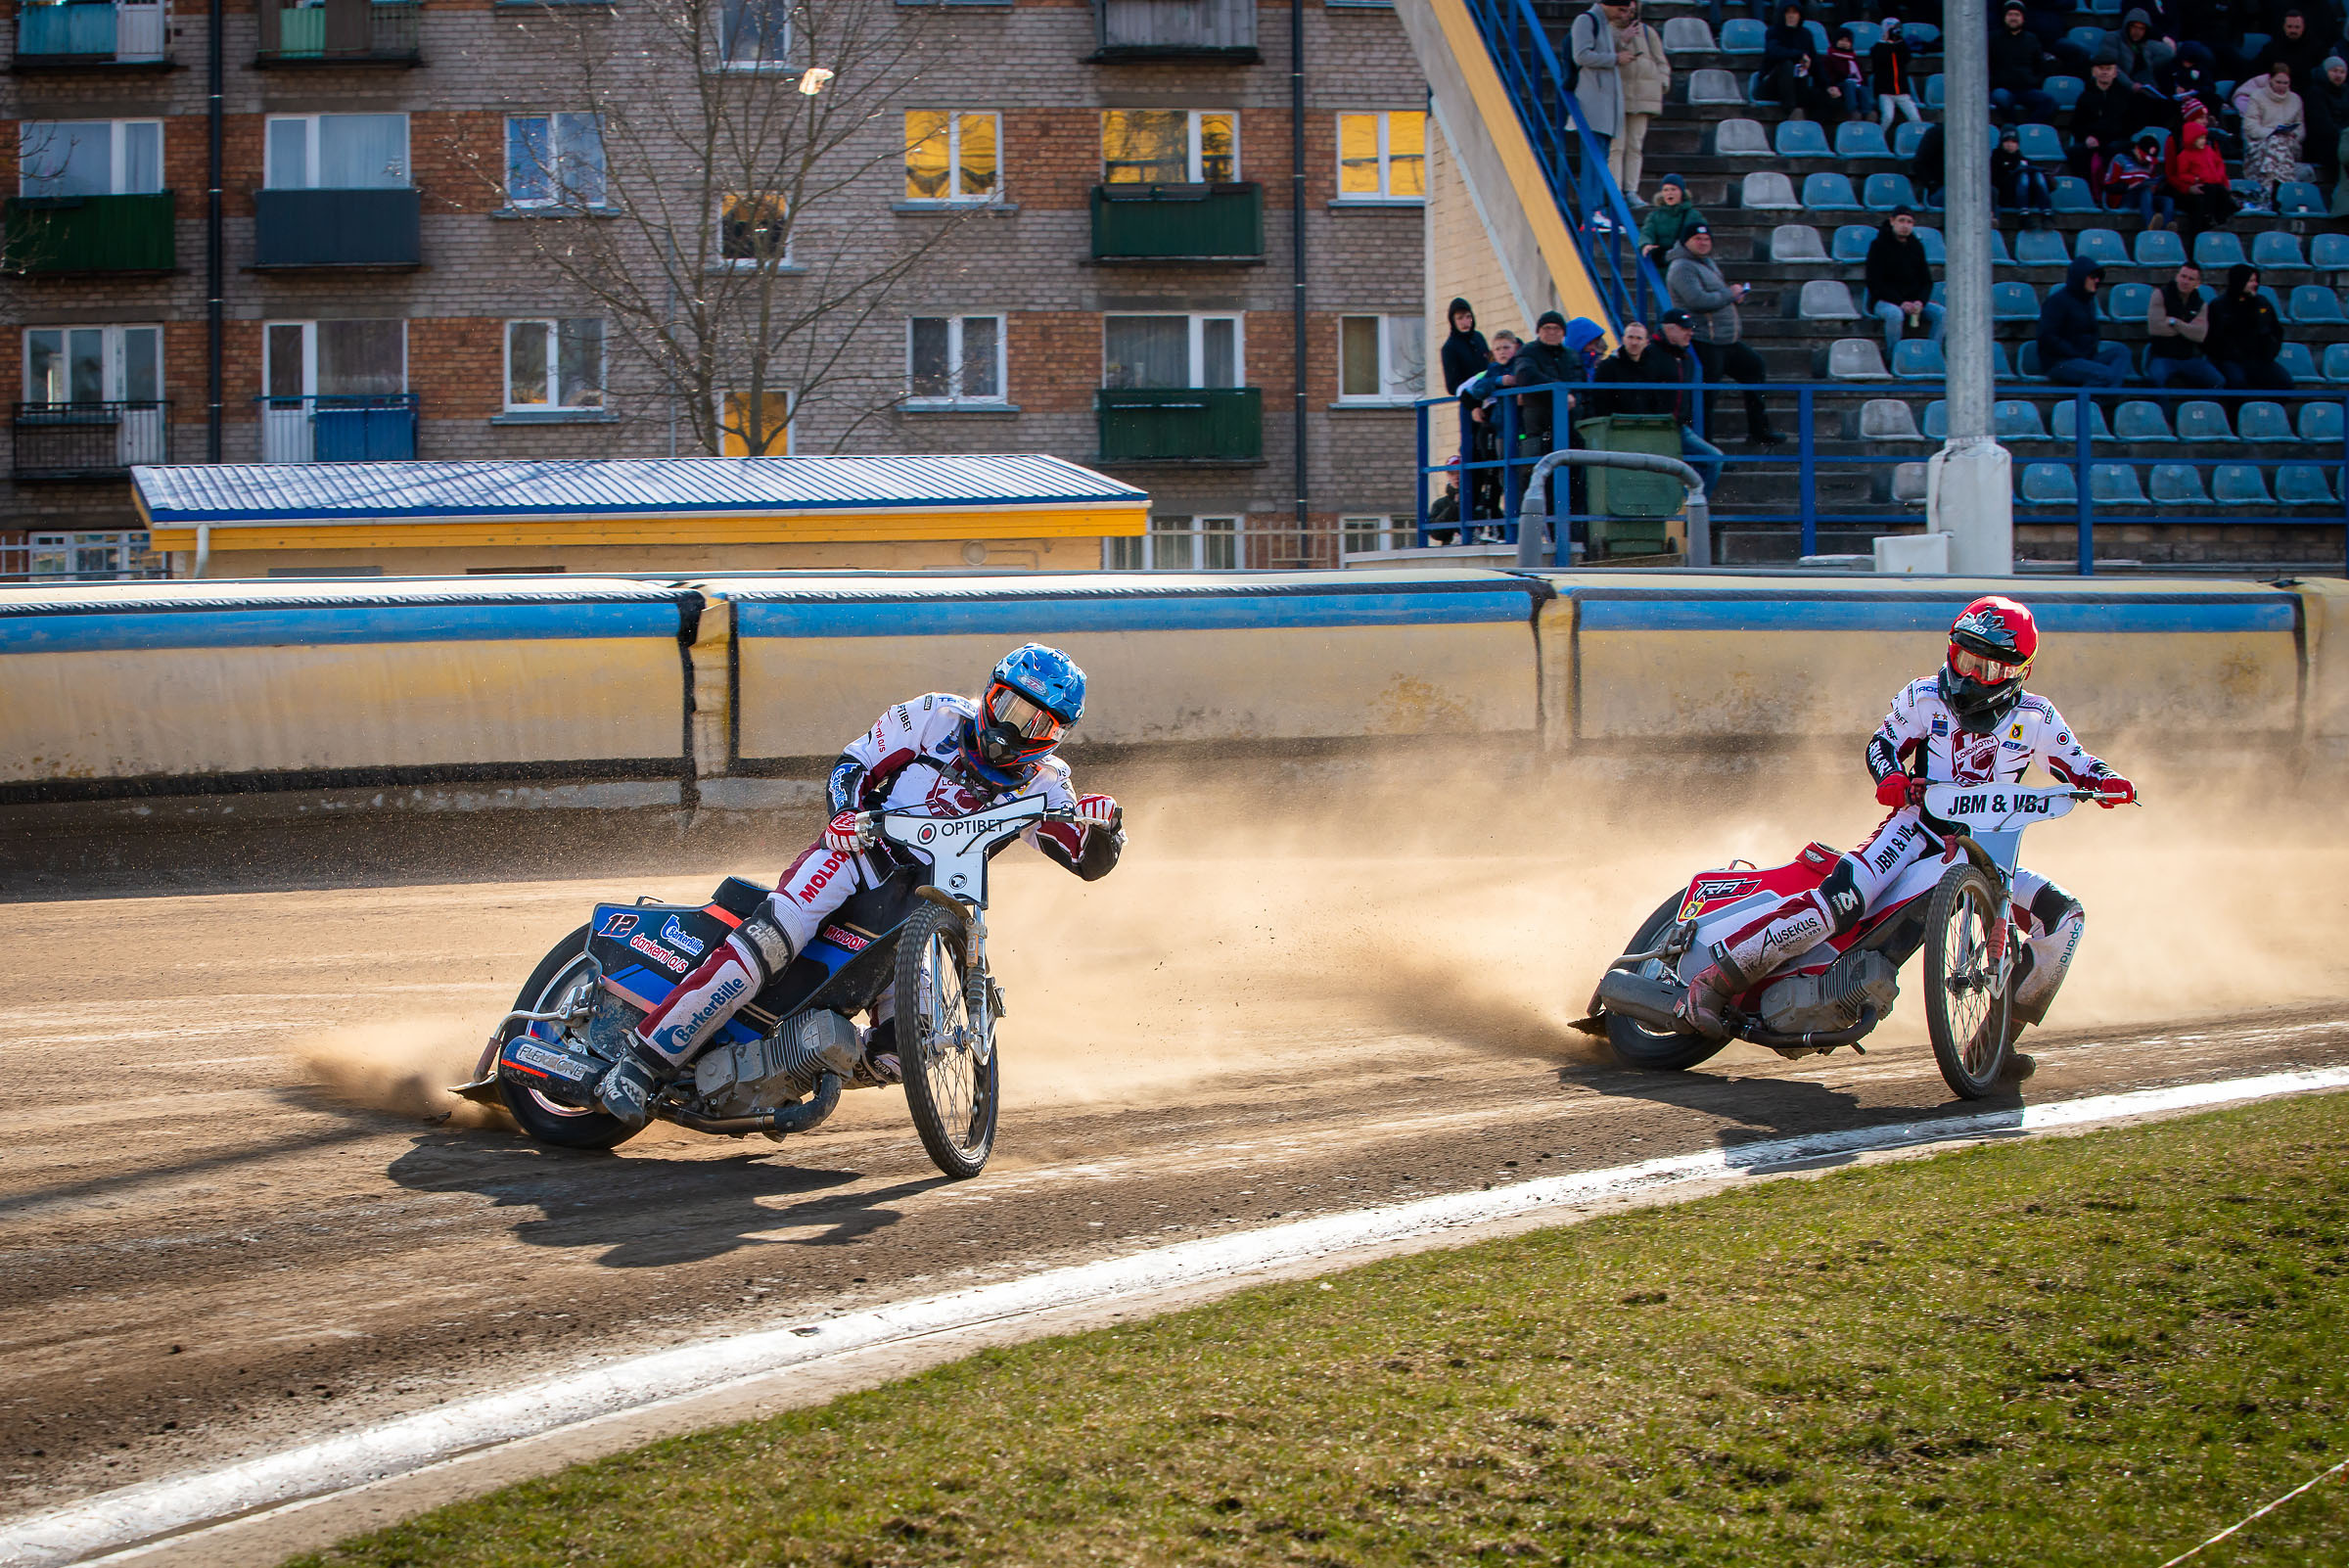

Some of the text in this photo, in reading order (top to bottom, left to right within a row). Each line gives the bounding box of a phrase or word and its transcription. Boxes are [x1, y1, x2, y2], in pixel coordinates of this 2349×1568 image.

[1947, 794, 2051, 816] JBM & VBJ
[941, 819, 1003, 837] OPTIBET
[1873, 845, 1901, 874] JBM
[1890, 838, 1908, 853] &
[799, 849, 852, 903] MOLDO
[597, 912, 640, 938] 12
[668, 926, 705, 953] BarkerBille
[629, 933, 675, 963] dankemi
[668, 955, 689, 974] a/s
[674, 978, 745, 1042] BarkerBille
